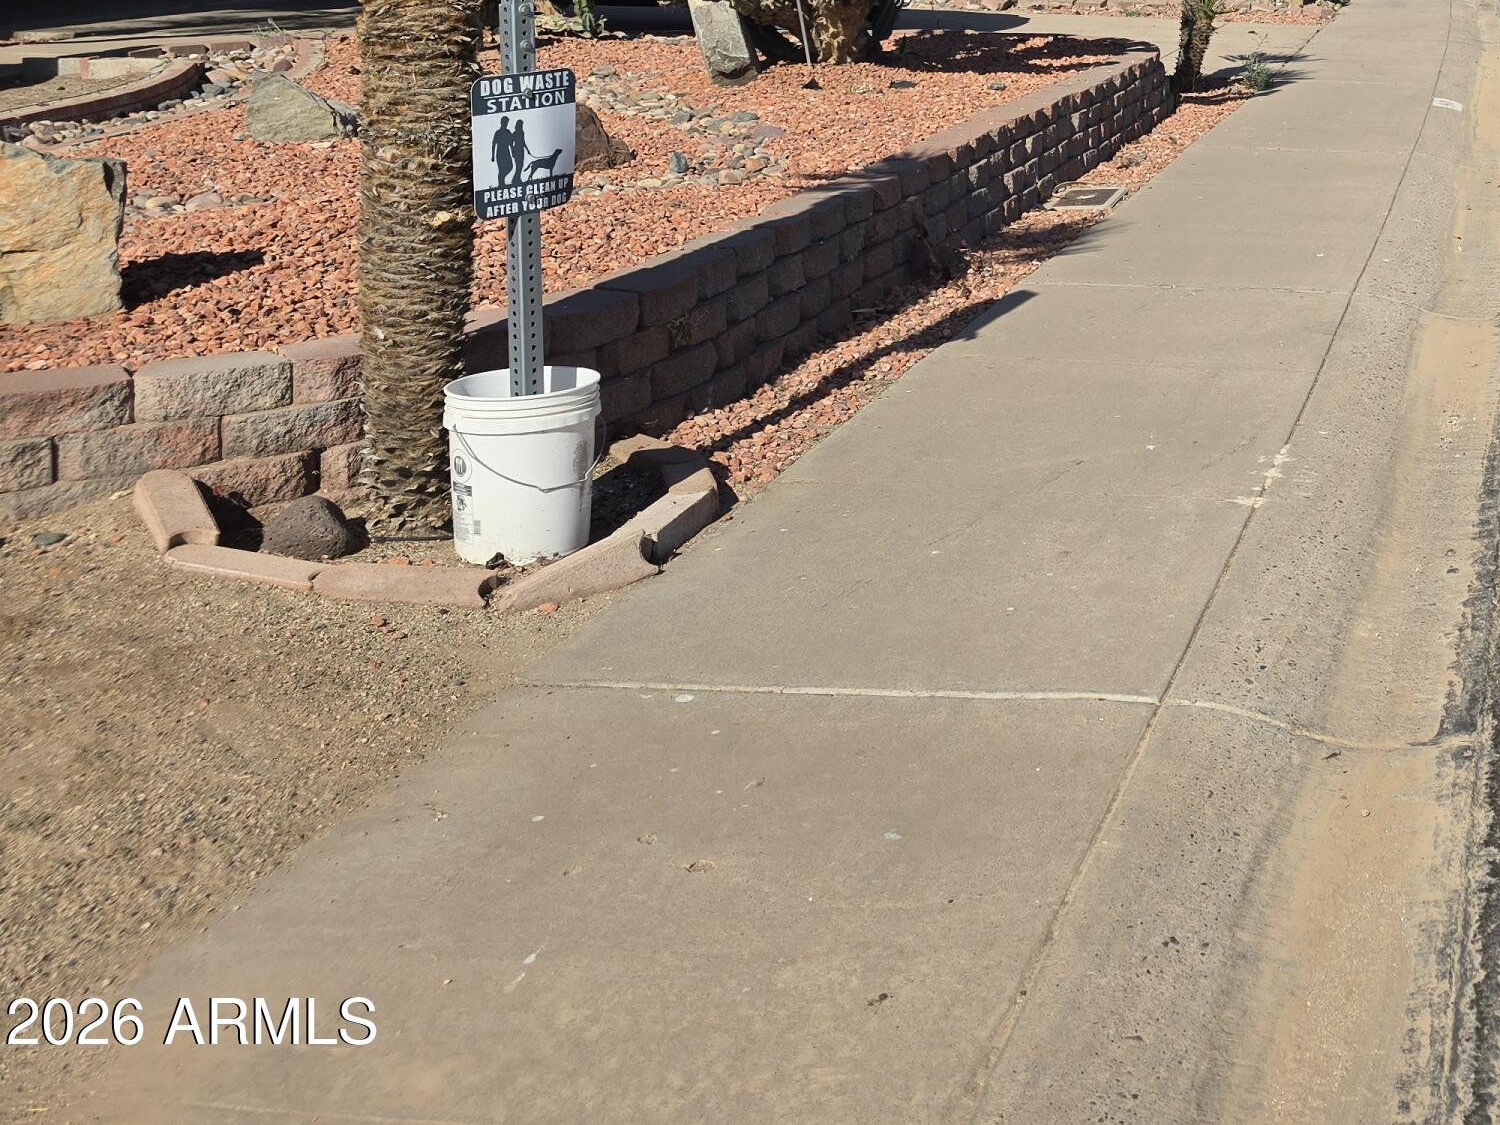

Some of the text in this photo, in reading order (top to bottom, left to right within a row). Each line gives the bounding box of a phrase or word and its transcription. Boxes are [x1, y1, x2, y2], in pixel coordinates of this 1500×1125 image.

[480, 71, 569, 97] DOG WASTE
[486, 91, 565, 113] STATION
[483, 177, 569, 203] PLEASE CLEAN UP
[486, 202, 519, 218] AFTER
[551, 192, 567, 206] DOG
